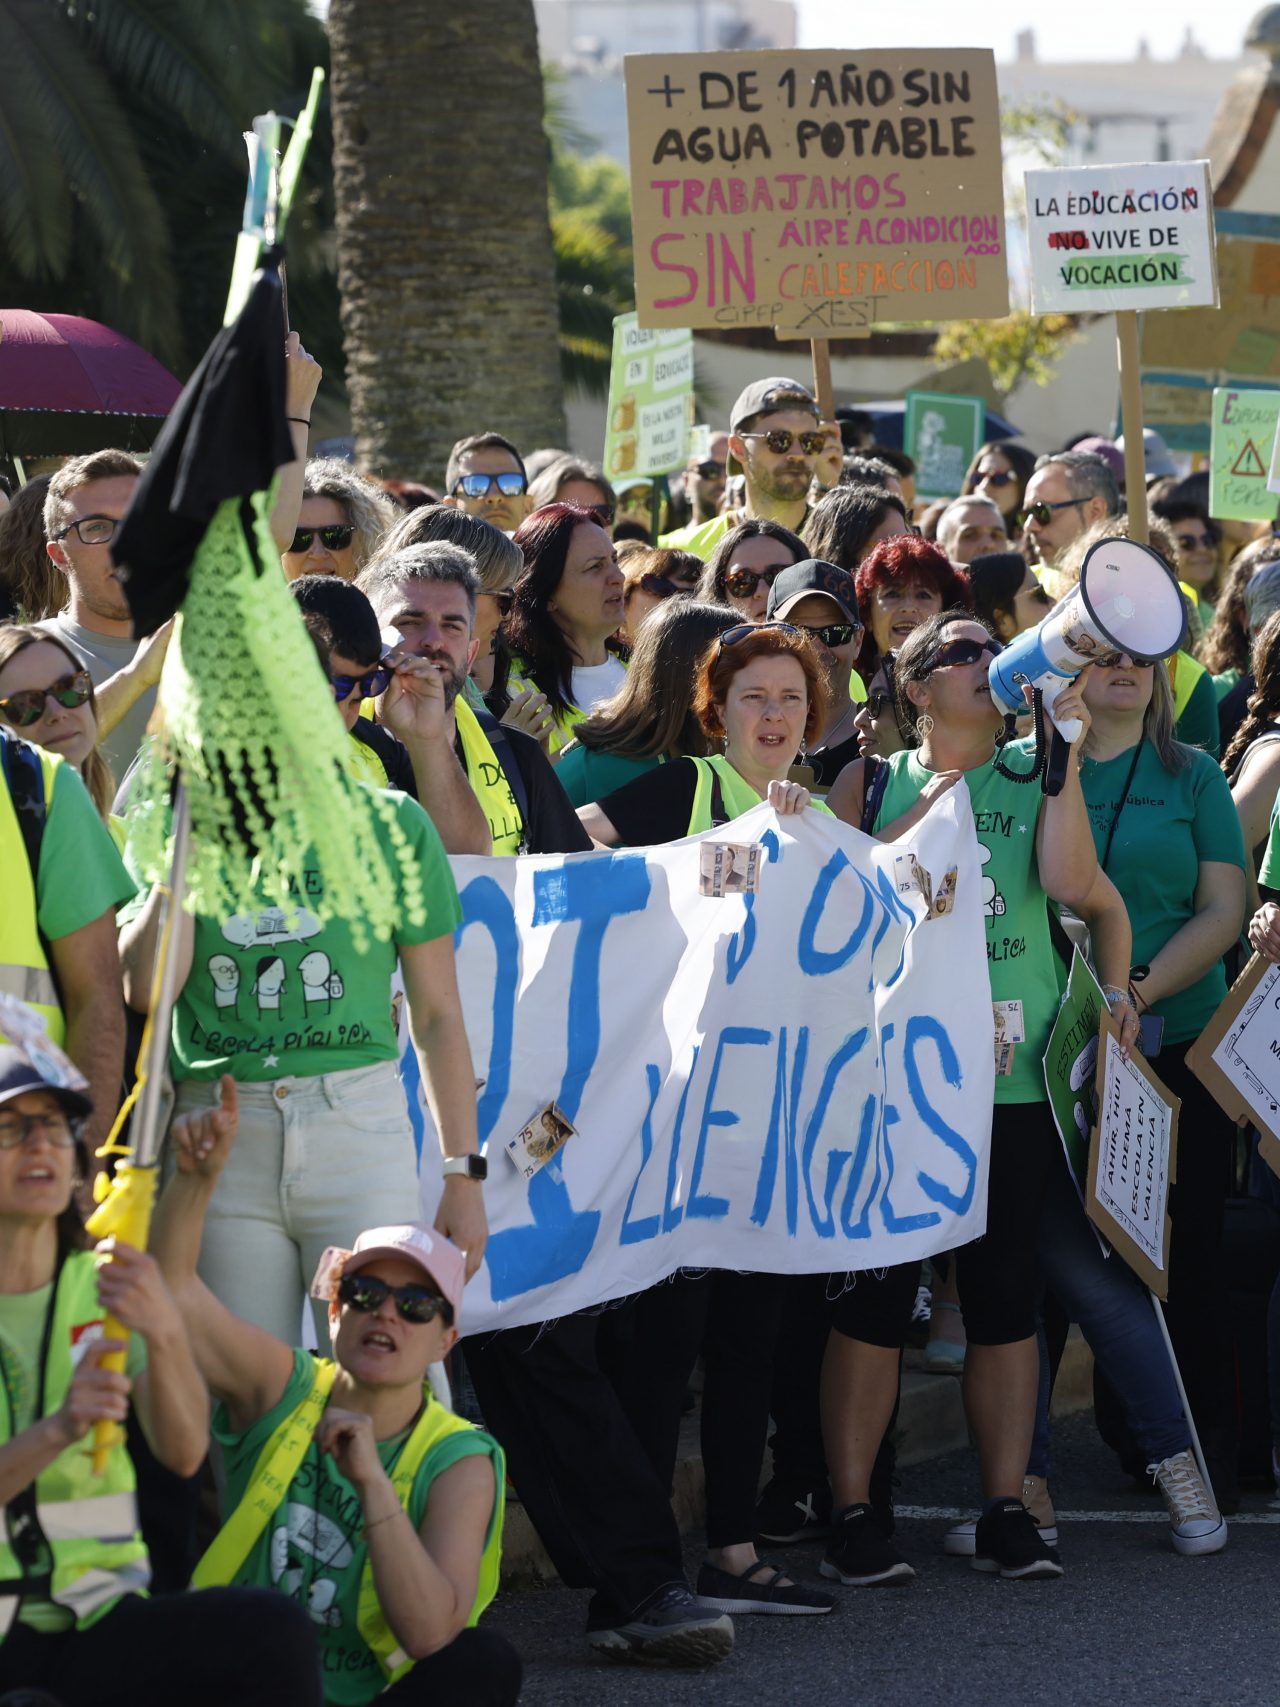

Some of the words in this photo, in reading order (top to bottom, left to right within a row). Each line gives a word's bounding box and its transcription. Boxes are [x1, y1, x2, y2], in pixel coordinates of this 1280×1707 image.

[647, 75, 685, 108] +
[699, 71, 763, 112] DE
[778, 68, 796, 108] 1
[809, 63, 895, 108] AÑO
[903, 68, 971, 107] SIN
[653, 123, 771, 165] AGUA
[796, 116, 976, 159] POTABLE
[651, 172, 906, 219] TRABAJAMOS
[1035, 198, 1060, 216] LA
[1067, 186, 1198, 216] EDUCACIÓN
[778, 217, 849, 248] AIRE
[855, 214, 998, 245] ACONDICION
[1055, 232, 1087, 251] NO
[1092, 229, 1141, 250] VIVE
[1150, 227, 1179, 247] DE
[651, 231, 756, 308] SIN
[778, 258, 977, 300] CALEFACCION
[1060, 258, 1178, 286] VOCACIÓN
[795, 295, 888, 330] XEST
[899, 881, 911, 892] 75
[1008, 1003, 1019, 1012] 75
[518, 1127, 533, 1145] 75
[524, 1165, 534, 1178] 75
[1108, 1129, 1119, 1185] AHIR,
[1131, 1135, 1143, 1215] ESCOLA
[1137, 1097, 1145, 1122] EN
[1143, 1116, 1156, 1222] VALENCIÀ
